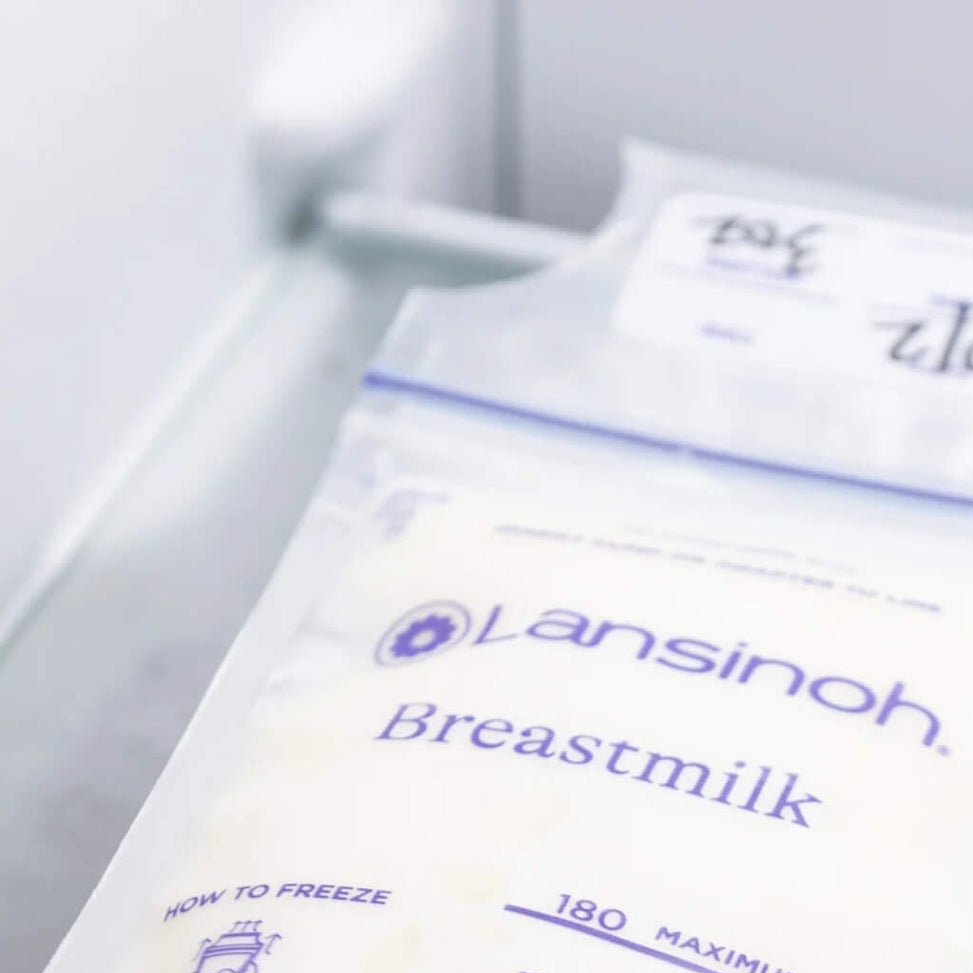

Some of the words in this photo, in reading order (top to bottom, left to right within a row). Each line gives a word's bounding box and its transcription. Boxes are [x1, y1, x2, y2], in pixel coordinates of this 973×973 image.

[471, 604, 943, 750] Lansinoh
[374, 701, 825, 829] Breastmilk
[164, 889, 227, 922] HOW
[234, 883, 271, 901] TO
[276, 883, 393, 906] FREEZE
[554, 893, 628, 932] 180
